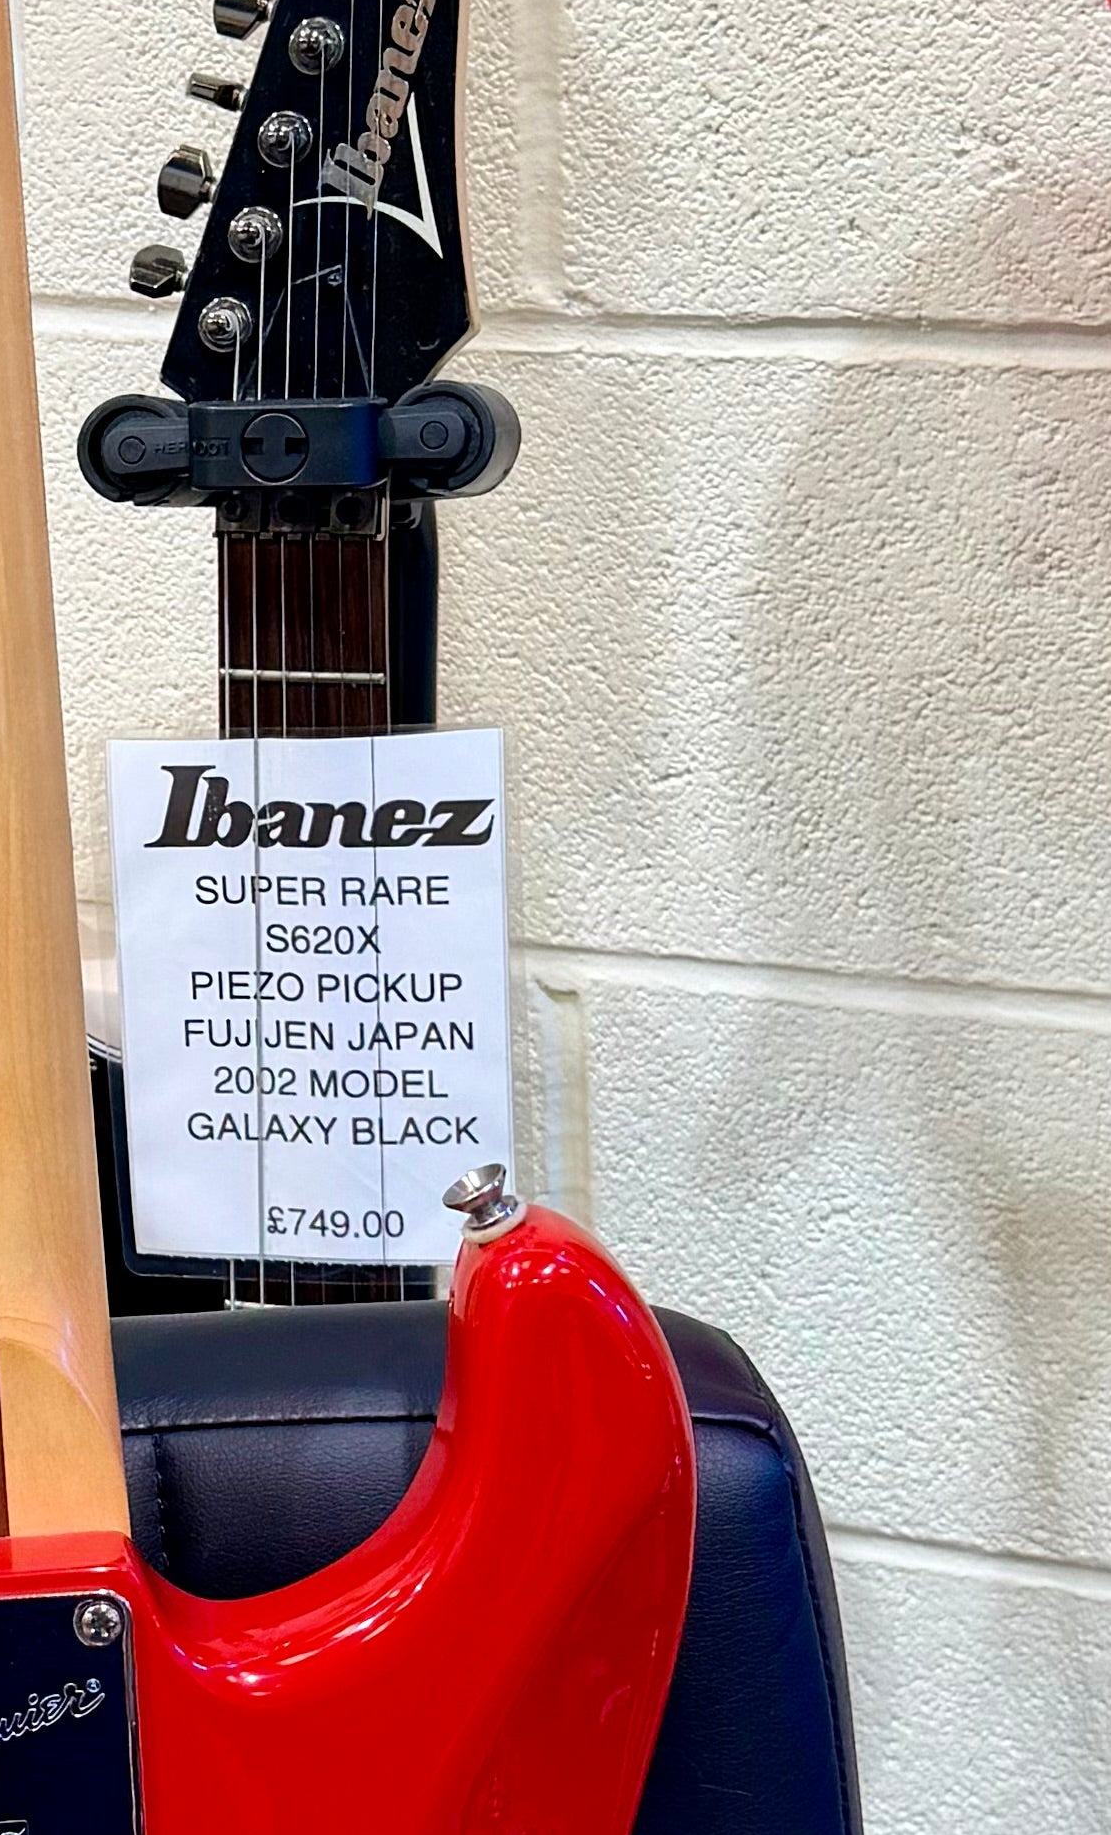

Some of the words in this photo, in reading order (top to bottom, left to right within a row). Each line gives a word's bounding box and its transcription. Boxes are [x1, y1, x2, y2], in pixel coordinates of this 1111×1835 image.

[144, 765, 495, 848] Ibanez
[195, 875, 326, 906] SUPER
[341, 875, 450, 906] RARE
[266, 923, 381, 955] S620X
[191, 970, 304, 1002] PIEZO
[317, 973, 462, 1003] PICKUP
[184, 1018, 334, 1051] FUJJEN
[347, 1021, 474, 1051] JAPAN
[214, 1066, 297, 1096] 2002
[310, 1069, 449, 1098] MODEL
[187, 1111, 338, 1145] GALAXY
[352, 1116, 479, 1145] BLACK
[267, 1205, 404, 1239] £749.00
